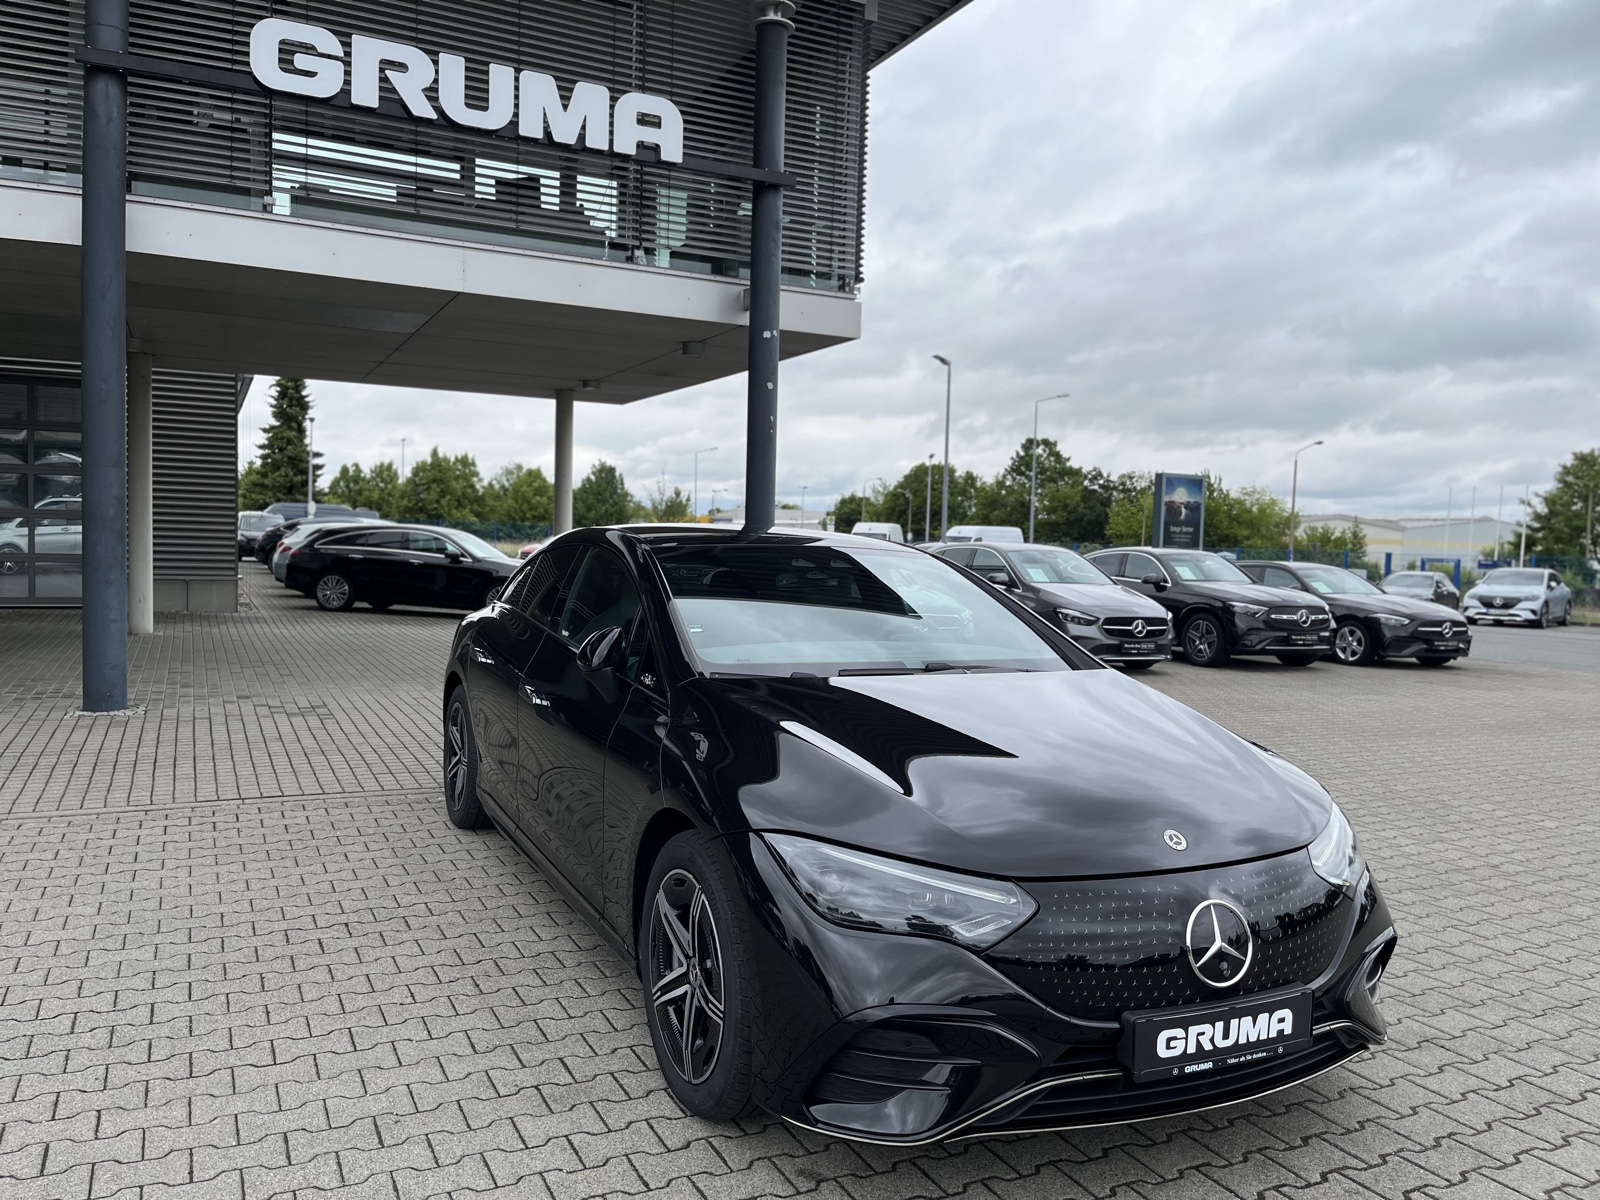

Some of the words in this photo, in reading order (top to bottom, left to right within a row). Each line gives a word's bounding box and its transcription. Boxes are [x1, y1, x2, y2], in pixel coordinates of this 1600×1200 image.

[250, 18, 683, 163] GRUMA
[687, 850, 723, 924] BRIDGESTONE
[1157, 1008, 1293, 1058] GRUMA
[1184, 1061, 1213, 1073] GRUMA
